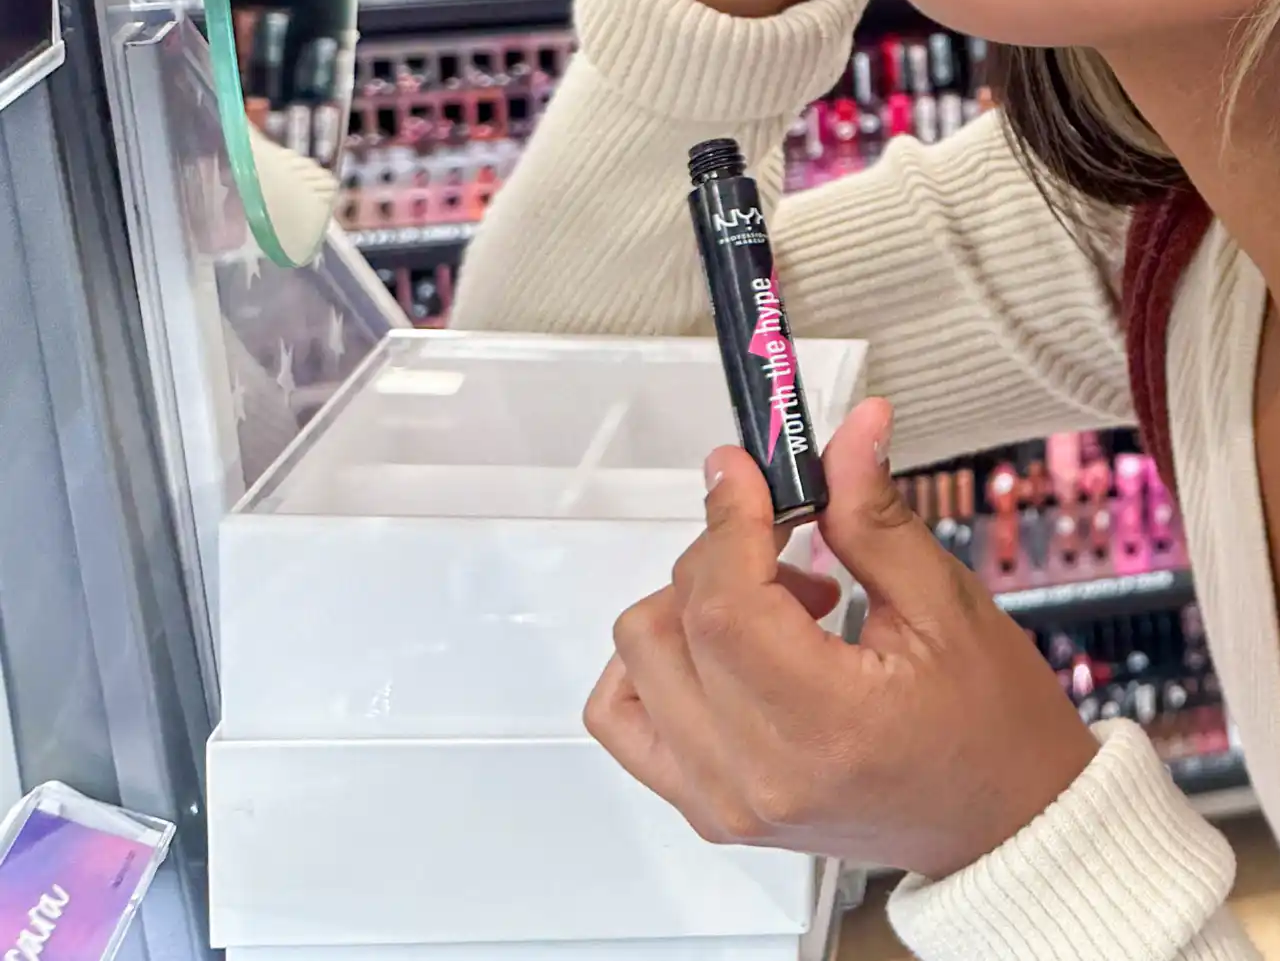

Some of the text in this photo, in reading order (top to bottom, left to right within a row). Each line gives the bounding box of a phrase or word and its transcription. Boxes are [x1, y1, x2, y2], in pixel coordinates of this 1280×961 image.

[712, 206, 764, 231] NYX
[752, 277, 809, 455] worth the hype
